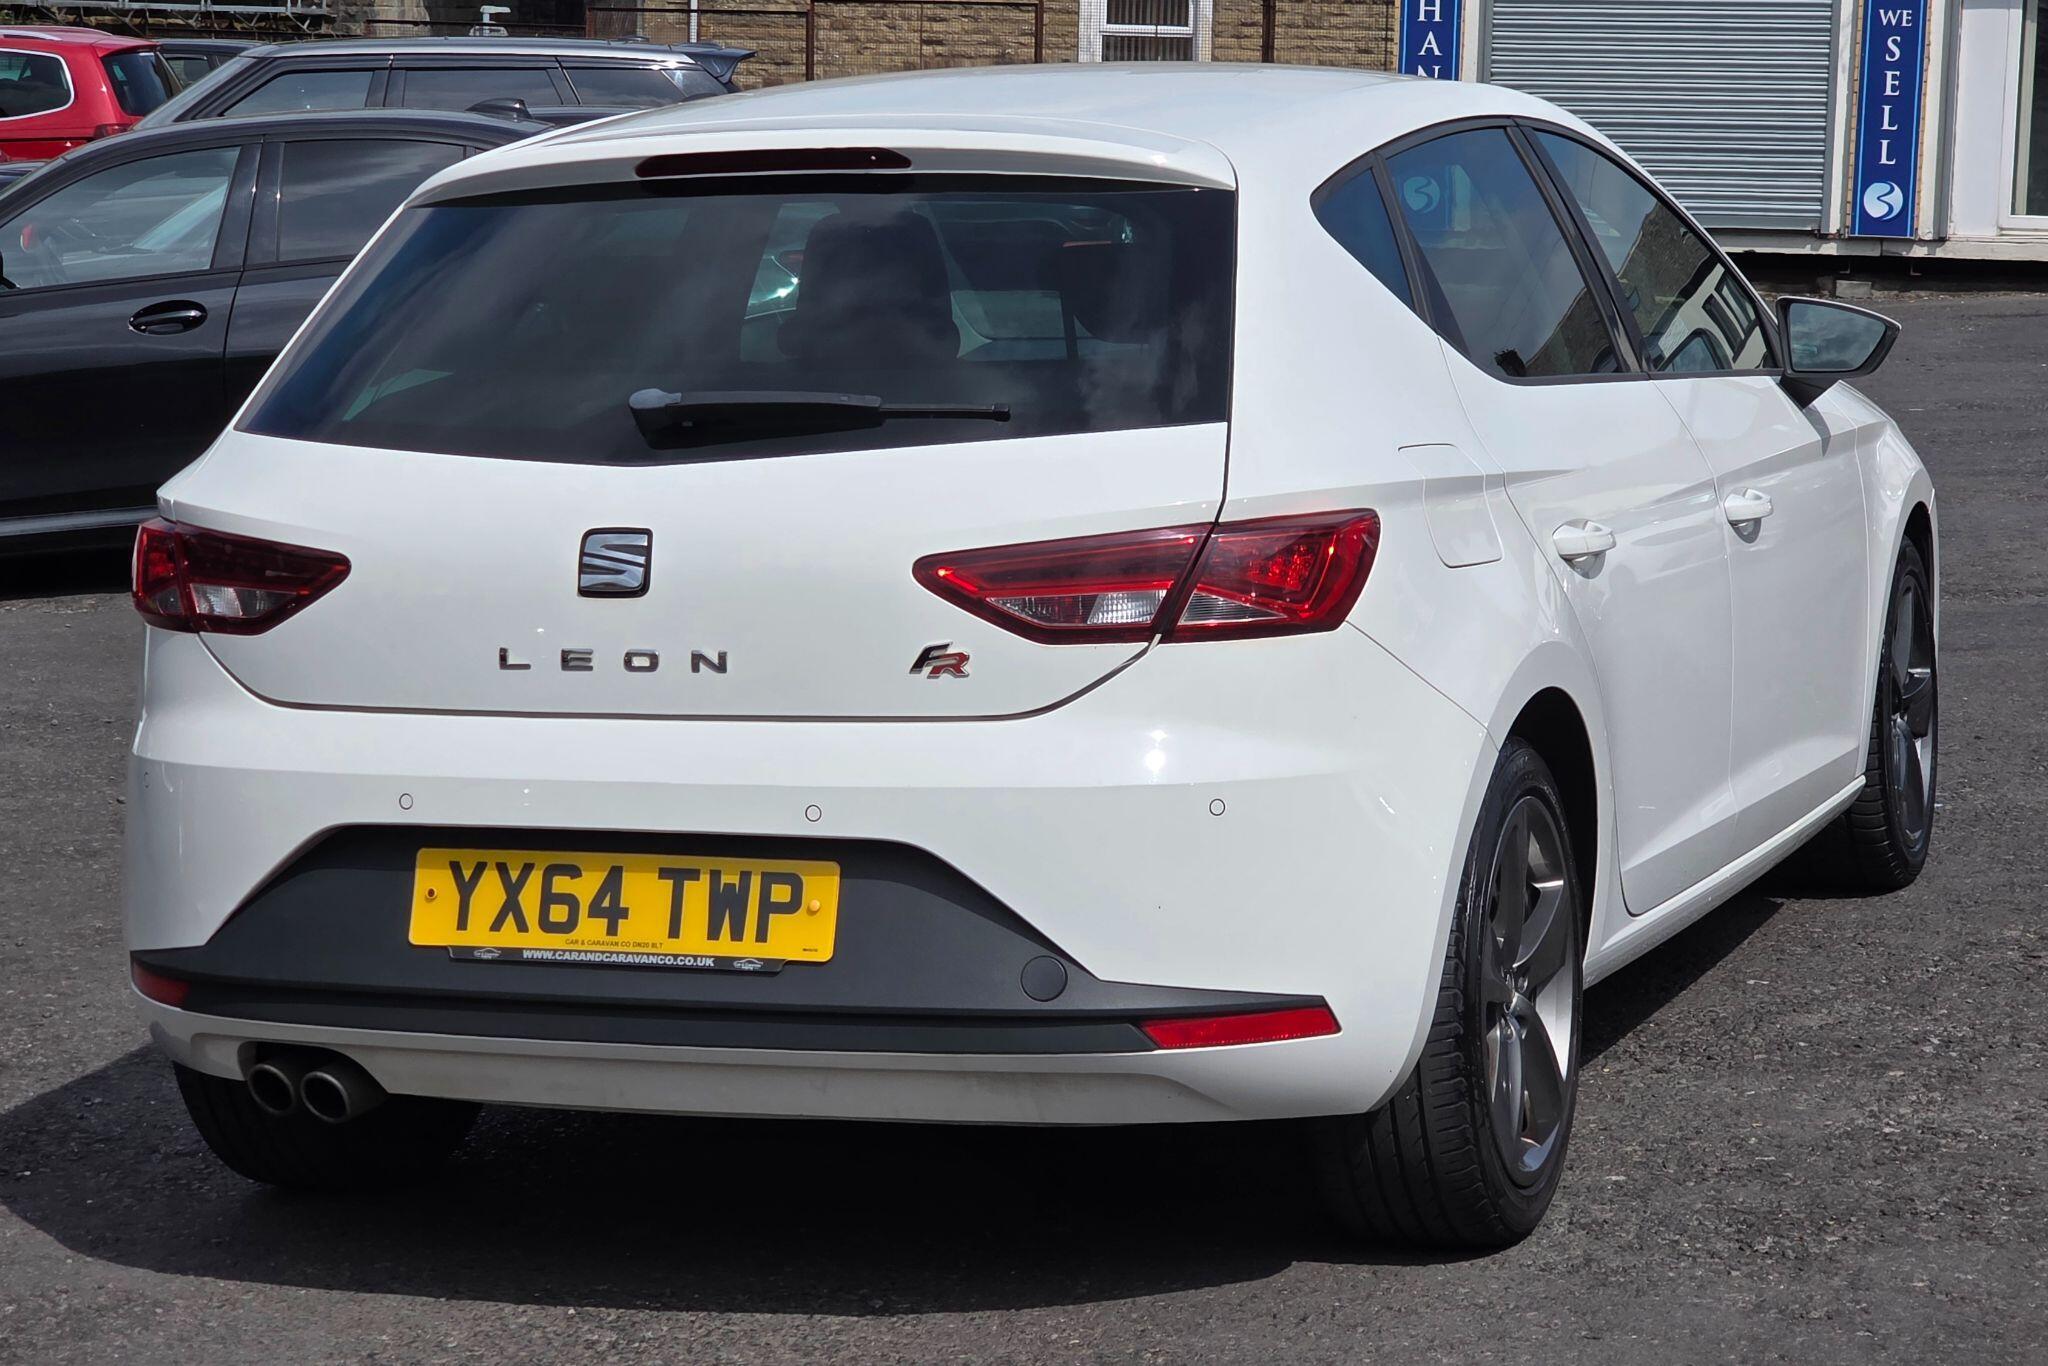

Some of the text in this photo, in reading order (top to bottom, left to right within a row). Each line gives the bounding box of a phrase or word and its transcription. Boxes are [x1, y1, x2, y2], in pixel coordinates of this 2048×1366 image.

[1878, 9, 1912, 27] WE
[1878, 36, 1901, 165] SELL
[499, 646, 728, 674] LEON
[908, 641, 970, 679] FR
[448, 860, 804, 943] YX64 TWP
[587, 939, 619, 947] CARAVAN
[522, 949, 715, 967] WWW.CARANDCARAVANCO.CO.UK
